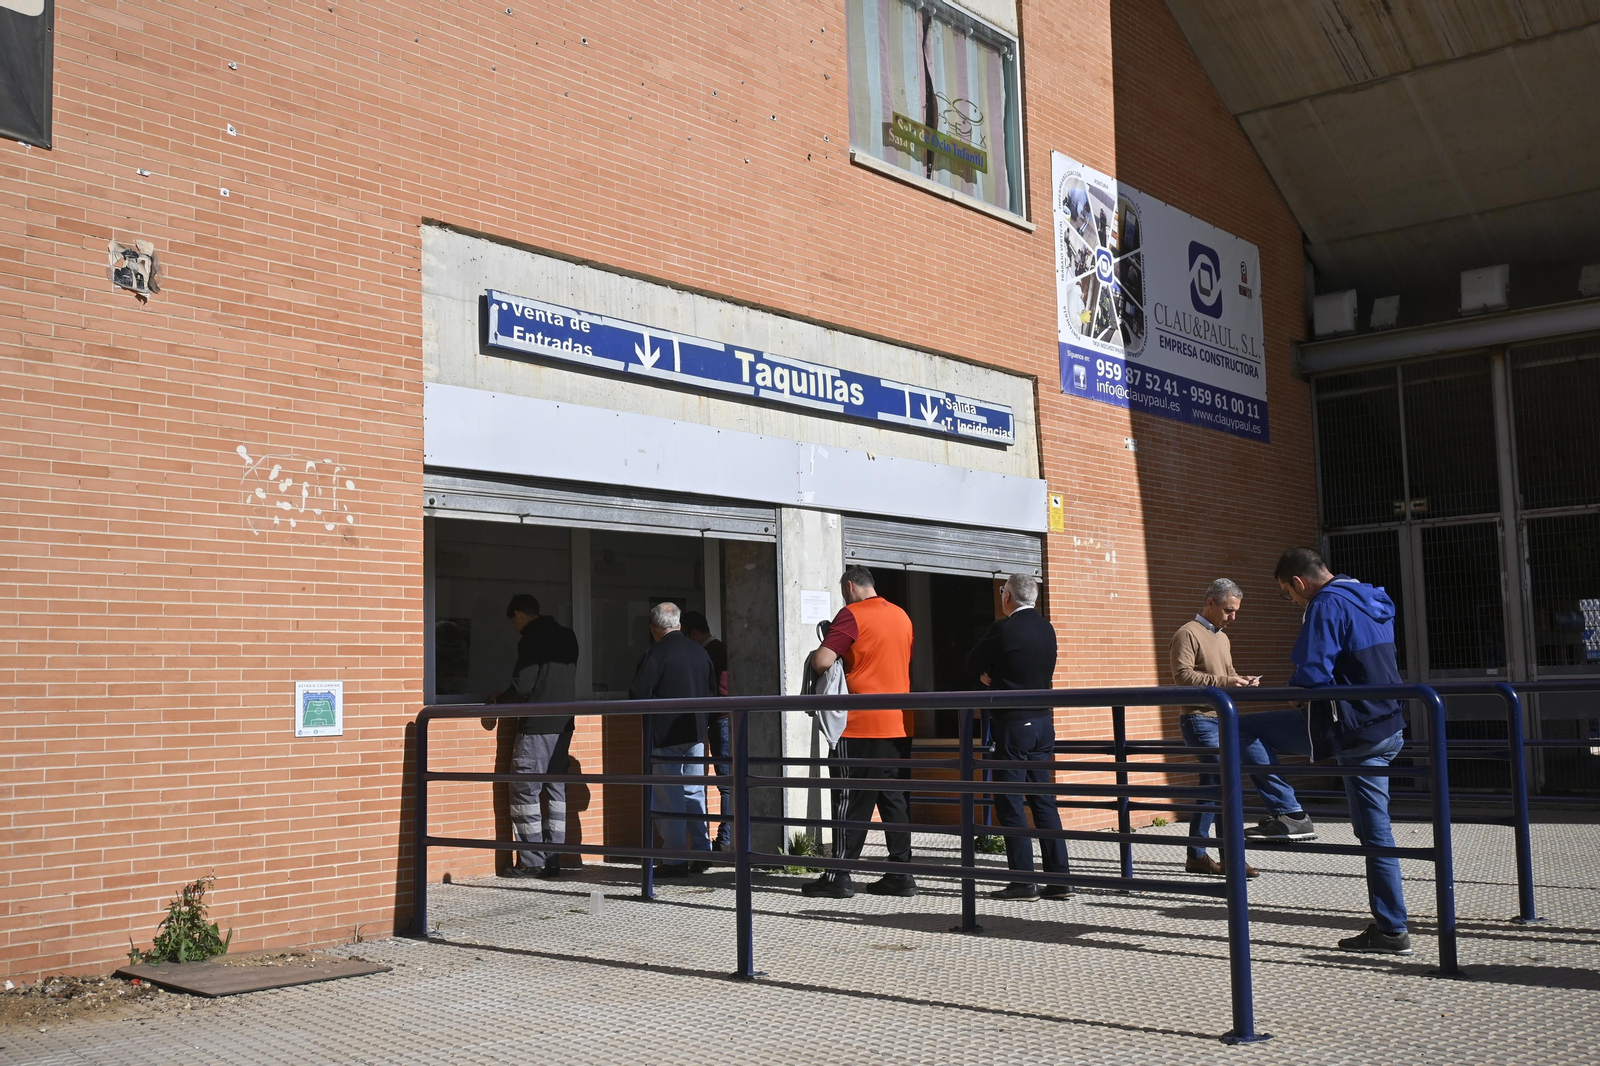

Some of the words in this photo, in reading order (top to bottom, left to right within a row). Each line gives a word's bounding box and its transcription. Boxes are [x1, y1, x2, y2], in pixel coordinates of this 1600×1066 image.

[919, 128, 930, 144] de
[931, 134, 952, 153] Ocio
[953, 143, 984, 167] Infantil
[510, 301, 564, 328] Venta
[569, 316, 591, 333] de
[1153, 302, 1239, 355] CLAU&PAUL,
[1240, 333, 1261, 359] S.L.
[512, 325, 594, 358] Entradas
[1159, 334, 1198, 359] EMPRESA
[1199, 348, 1260, 379] CONSTRUCTORA
[734, 350, 865, 406] Taquillas
[1096, 358, 1122, 381] 959
[1125, 366, 1142, 386] 87
[1145, 371, 1161, 390] 52
[1164, 377, 1179, 397] 41
[1190, 386, 1212, 405] 959
[1215, 392, 1229, 411] 61
[1231, 397, 1245, 415] 00
[1247, 402, 1260, 419] 11
[1096, 378, 1181, 412] info@clauypaul.es
[945, 397, 977, 415] Salida
[1192, 407, 1262, 435] www.clauypaul.es
[945, 416, 954, 431] T.
[957, 418, 1013, 440] Incidencias
